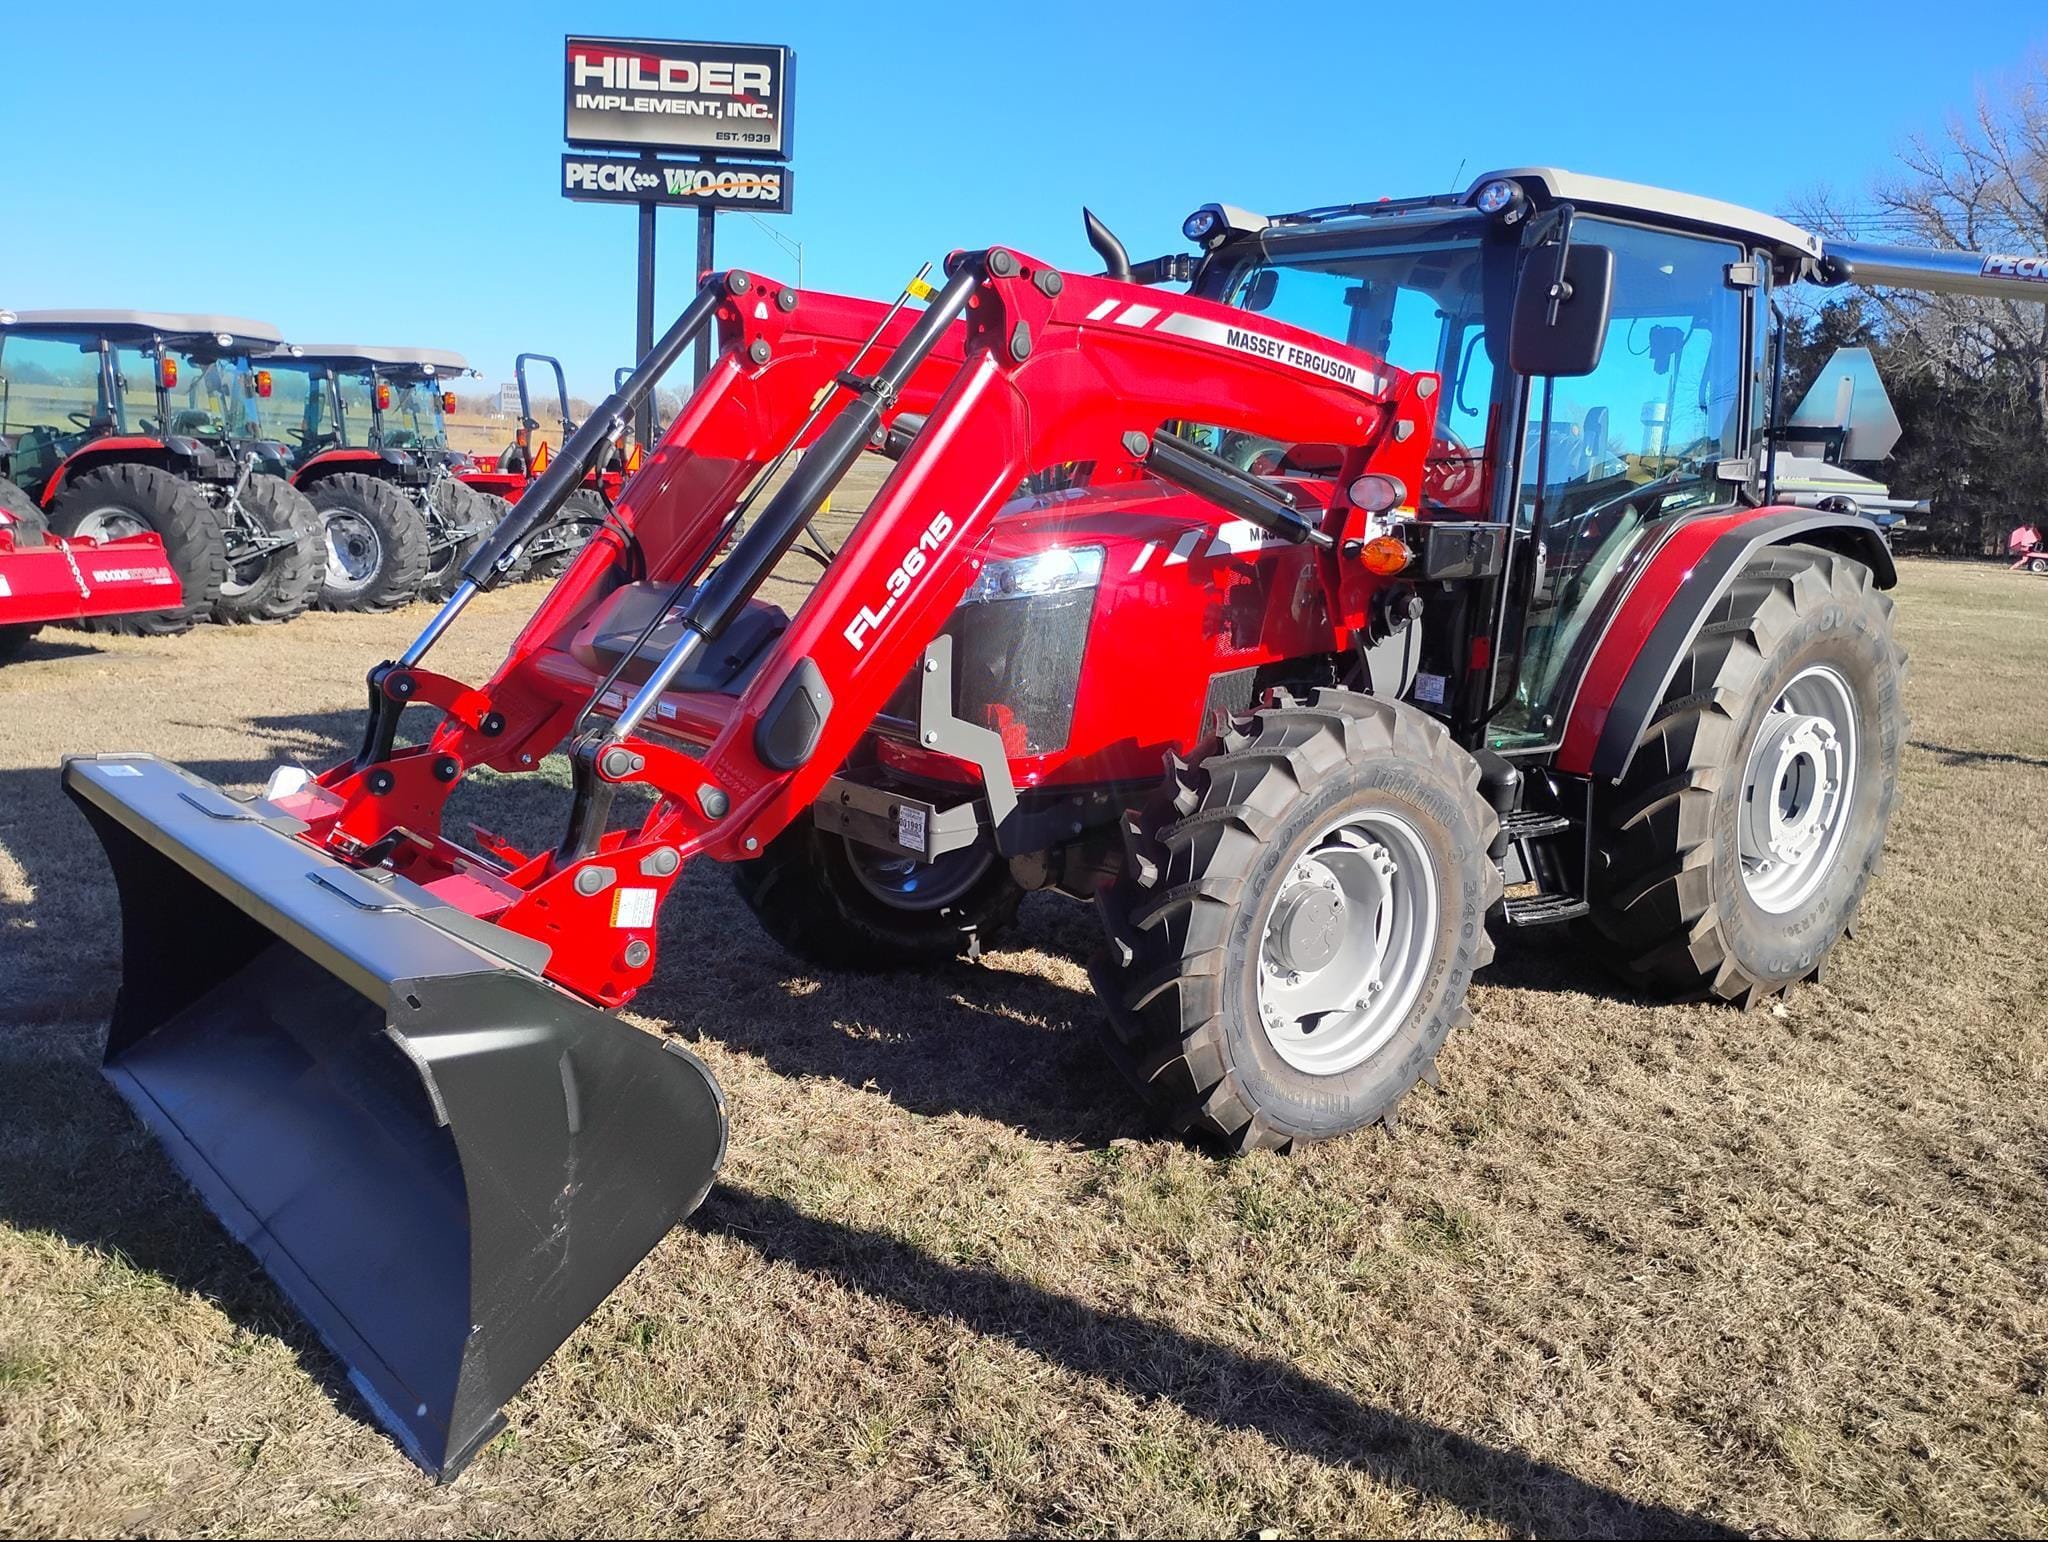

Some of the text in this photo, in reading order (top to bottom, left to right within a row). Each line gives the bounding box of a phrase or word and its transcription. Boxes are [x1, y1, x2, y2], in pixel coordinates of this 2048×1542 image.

[574, 55, 771, 96] HILDER
[575, 94, 773, 119] IMPLEMENT, INC.
[716, 131, 771, 143] EST. 1939
[565, 162, 781, 202] PECK WOODS
[1226, 328, 1357, 384] MASSEY FERGUSON
[842, 510, 954, 651] FL.3615
